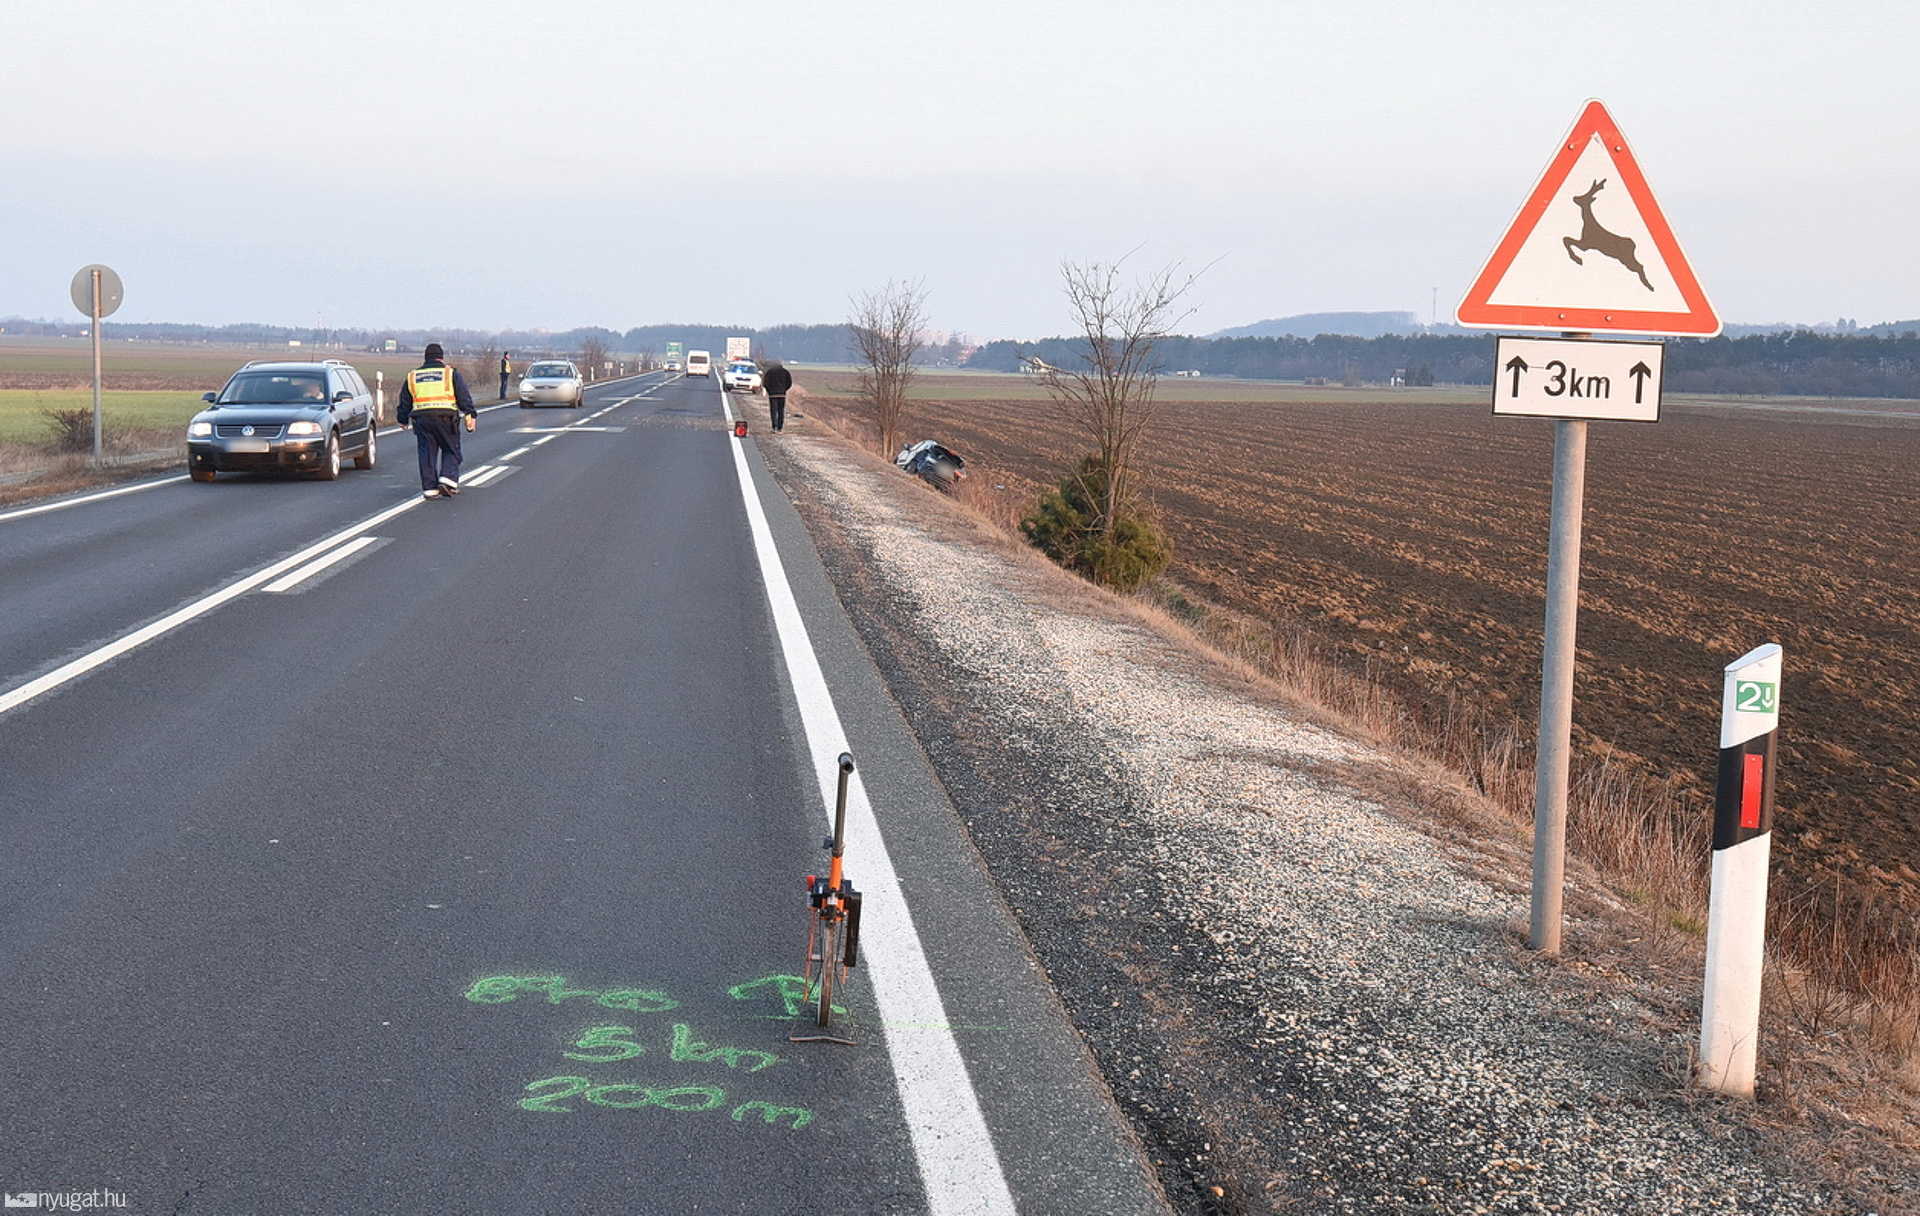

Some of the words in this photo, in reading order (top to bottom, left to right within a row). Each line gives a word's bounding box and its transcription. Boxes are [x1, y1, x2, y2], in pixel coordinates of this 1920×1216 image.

[1543, 359, 1611, 400] 3km
[1737, 682, 1762, 711] 2
[563, 1025, 642, 1063] 5
[517, 1075, 727, 1113] 200
[731, 1100, 814, 1130] m
